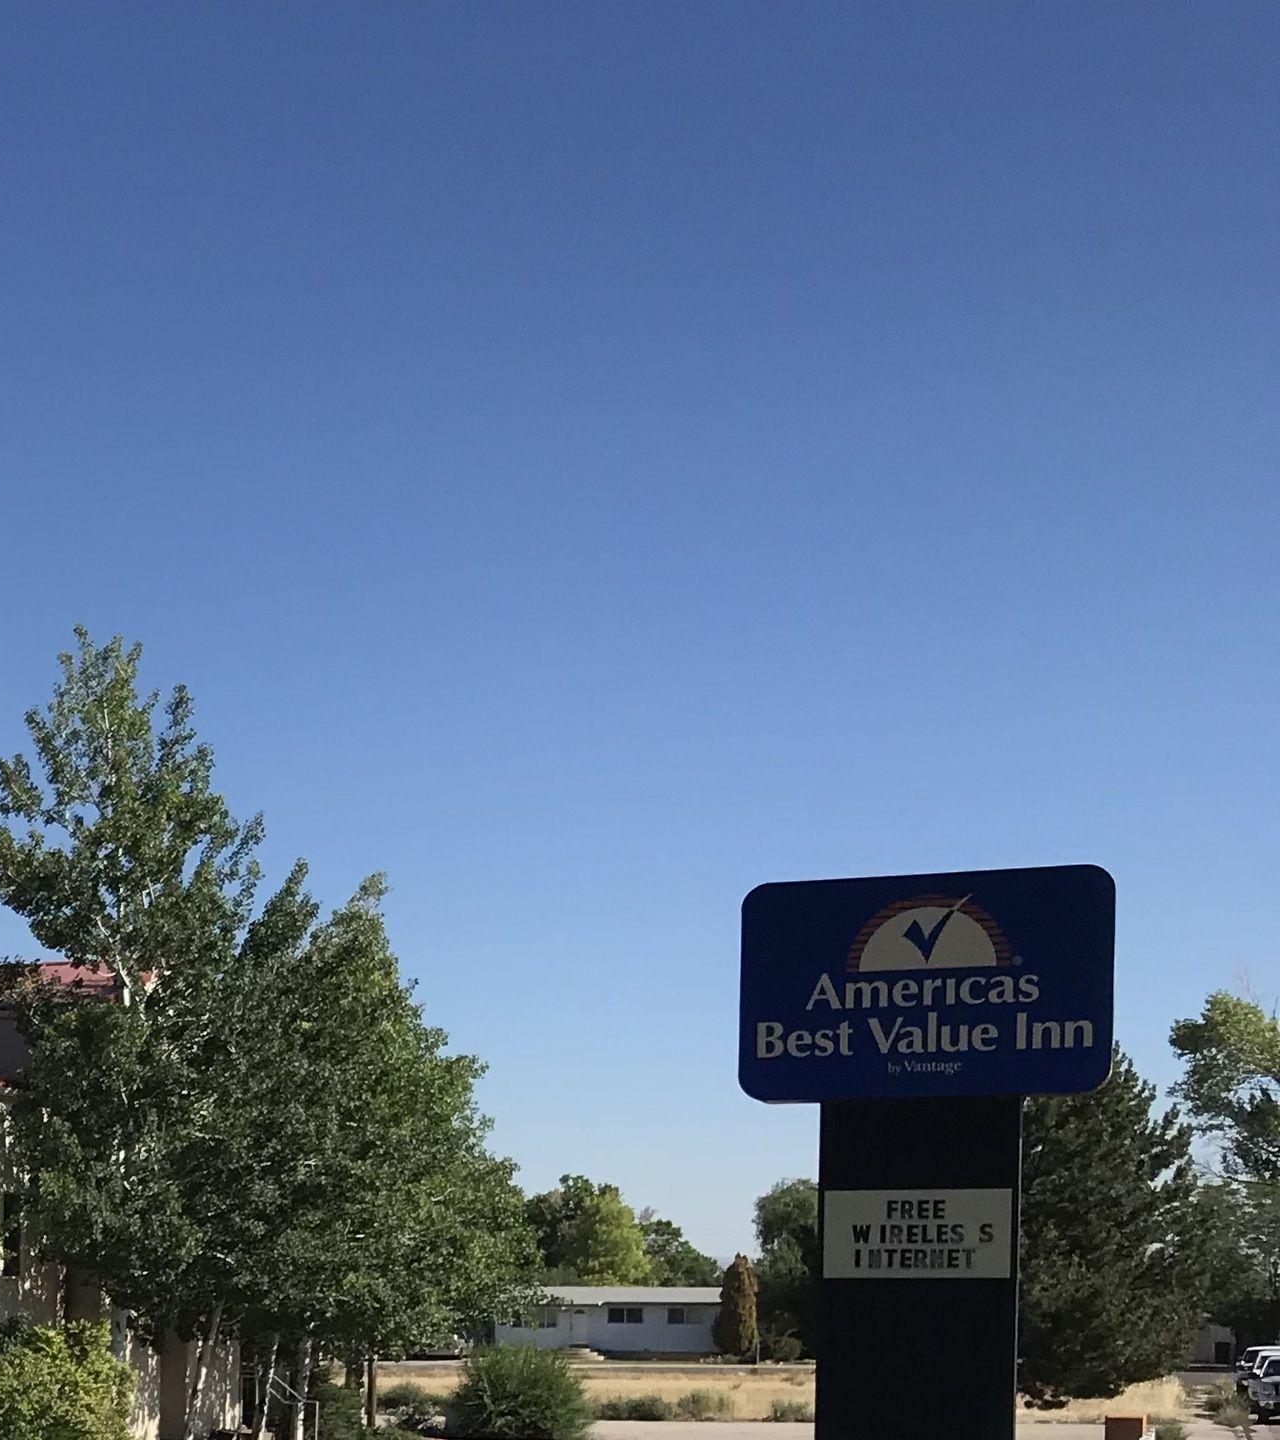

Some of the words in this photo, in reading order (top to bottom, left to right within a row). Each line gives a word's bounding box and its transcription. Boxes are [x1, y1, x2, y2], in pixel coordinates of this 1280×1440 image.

[805, 972, 1040, 1010] Americas
[756, 1020, 854, 1059] Best
[867, 1012, 999, 1055] Value
[1015, 1012, 1094, 1050] Inn
[887, 1062, 902, 1076] by
[904, 1060, 962, 1075] Vantage
[886, 1199, 946, 1220] FREE
[854, 1248, 977, 1269] INTERNET
